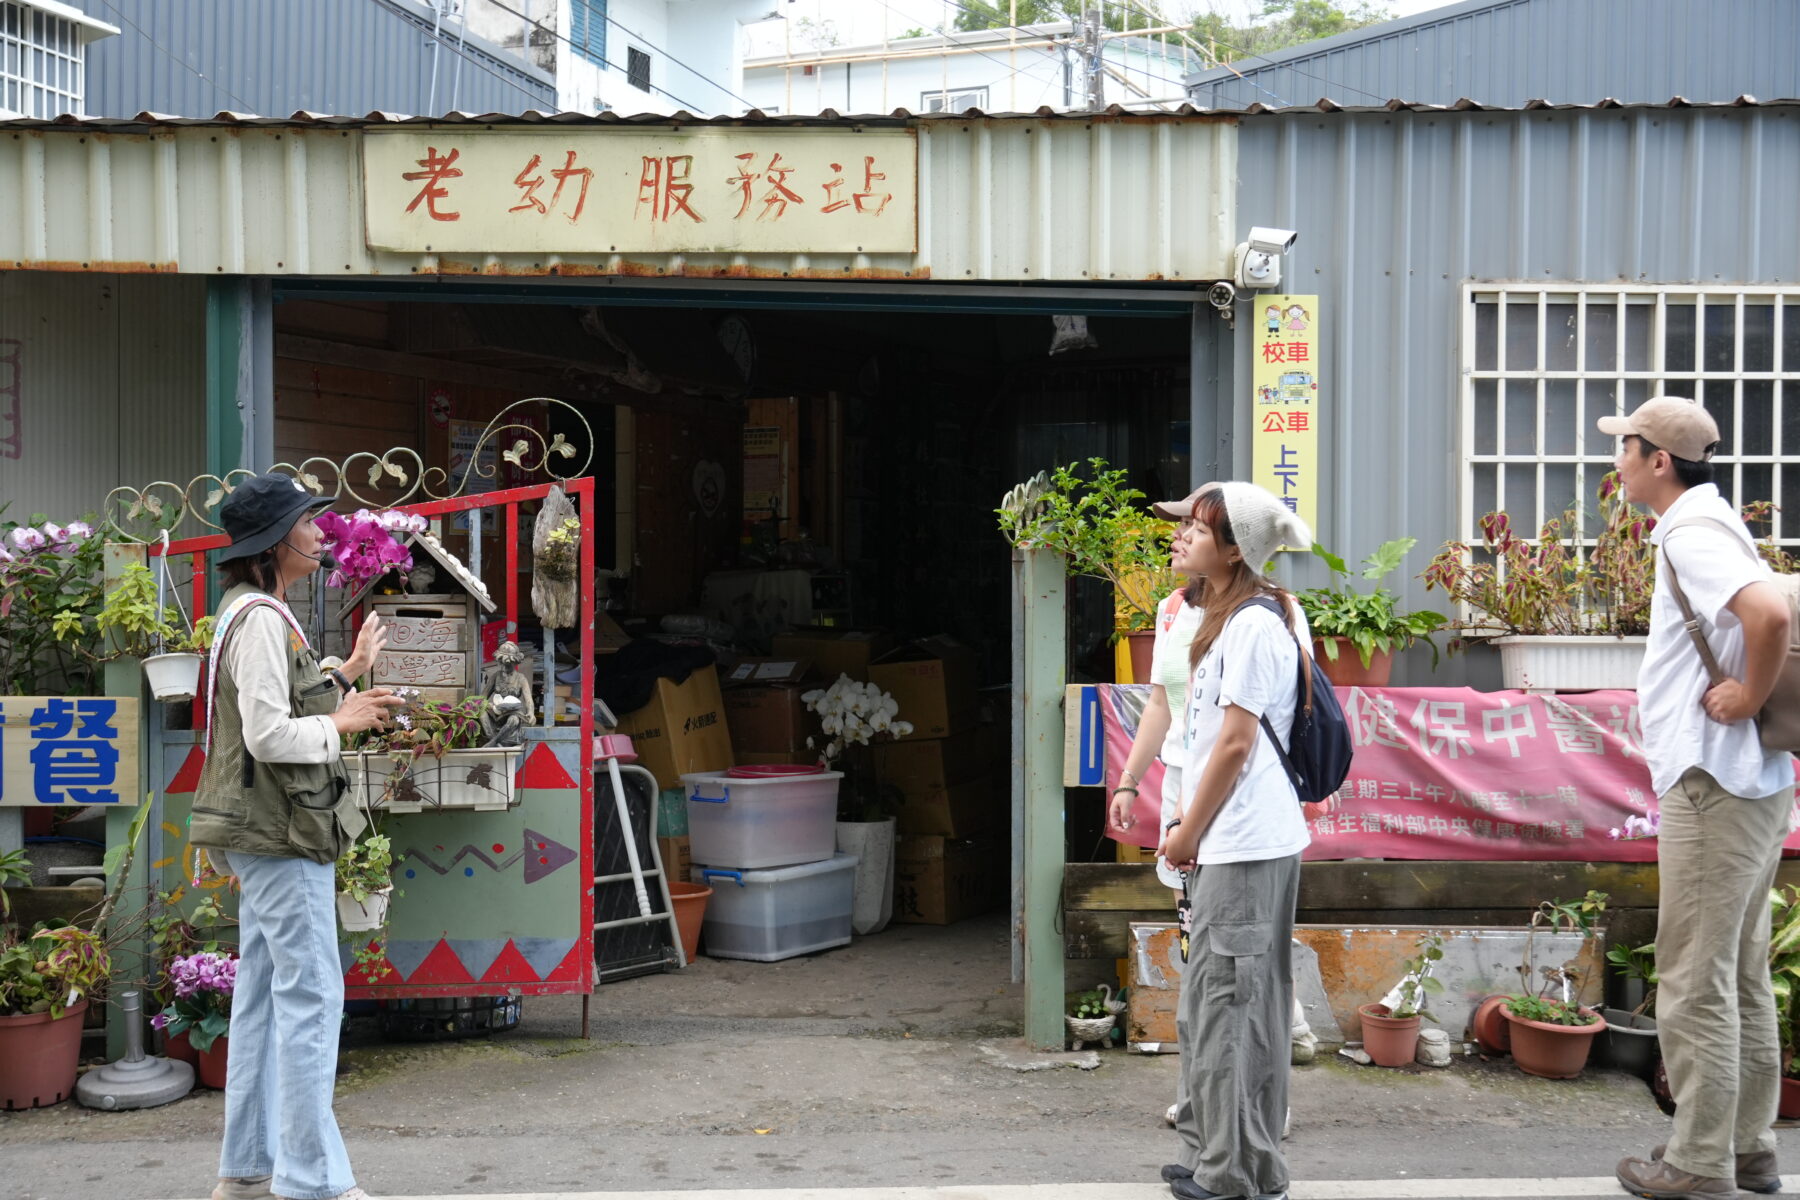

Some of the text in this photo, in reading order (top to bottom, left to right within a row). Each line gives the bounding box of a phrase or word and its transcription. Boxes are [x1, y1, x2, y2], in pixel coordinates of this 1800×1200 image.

[402, 147, 892, 225] 老幼服務站
[1262, 342, 1310, 363] 校車
[1262, 411, 1310, 433] 公車
[386, 620, 457, 649] 旭海
[378, 655, 460, 683] 小學堂
[0, 699, 119, 803] 餐
[1306, 812, 1584, 840] 衛生福利部中央健康保險署
